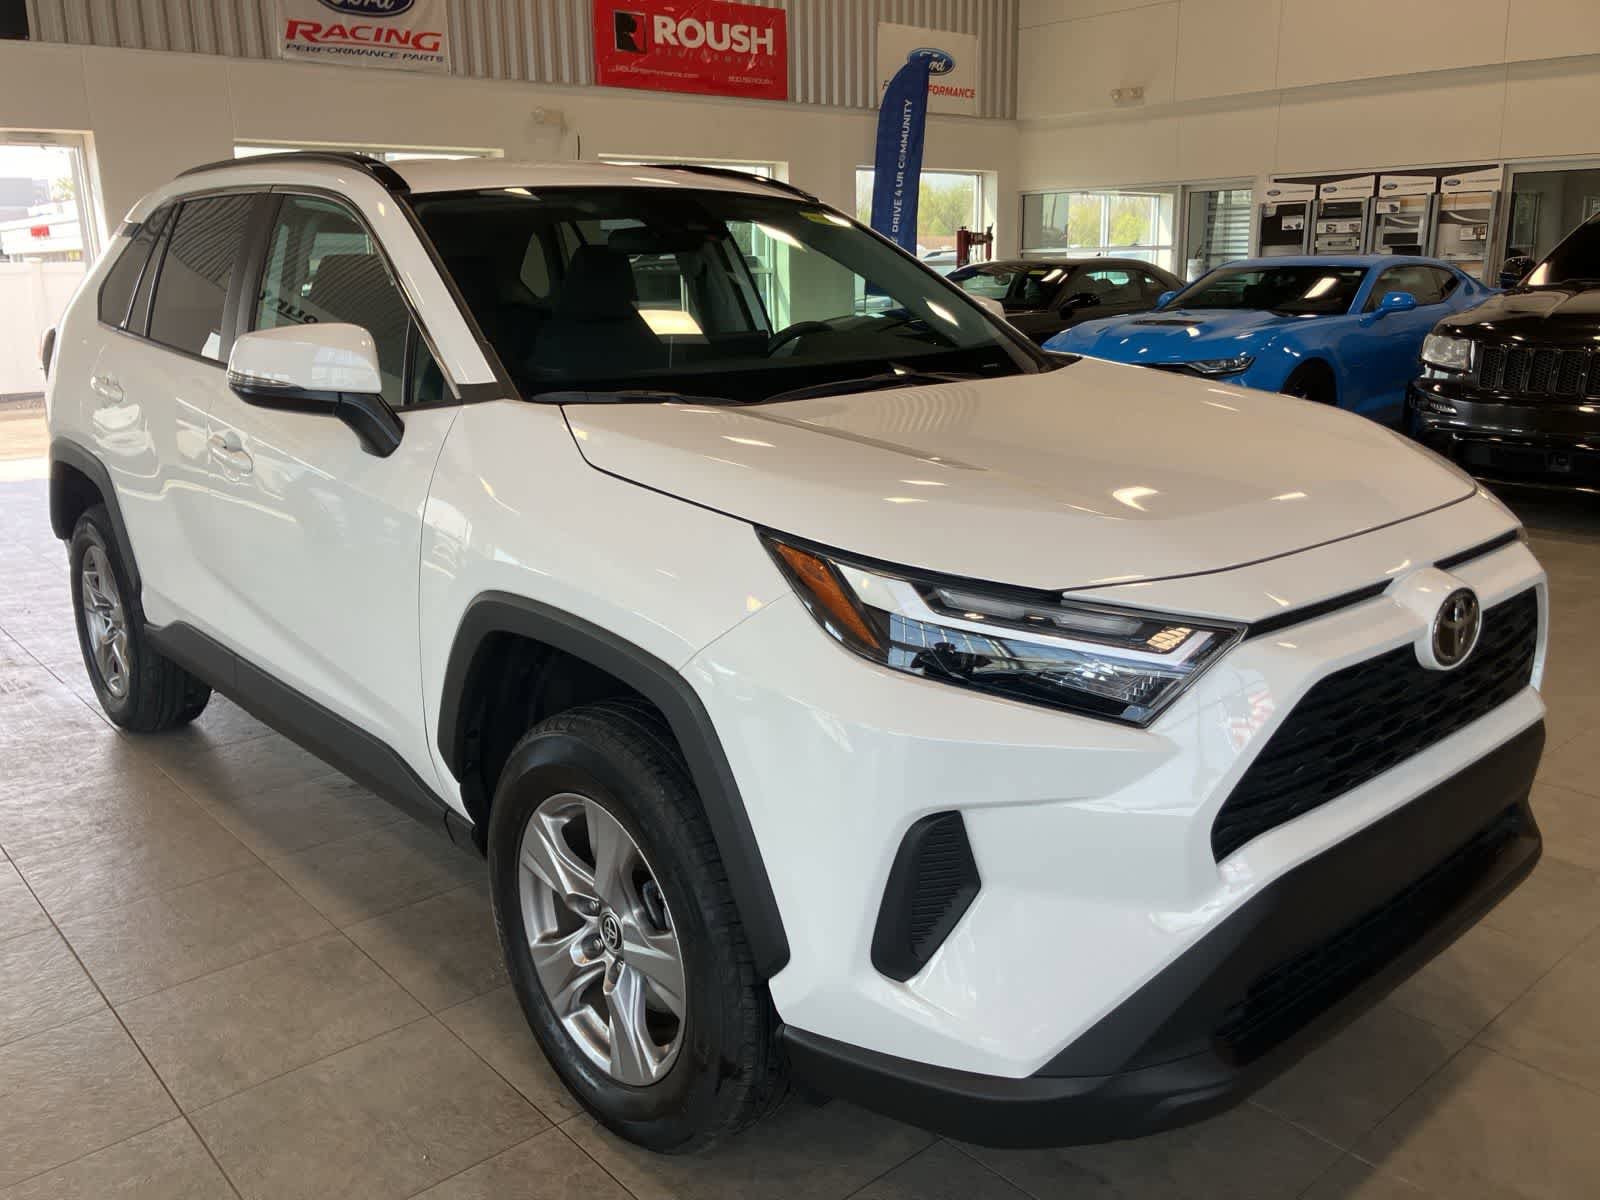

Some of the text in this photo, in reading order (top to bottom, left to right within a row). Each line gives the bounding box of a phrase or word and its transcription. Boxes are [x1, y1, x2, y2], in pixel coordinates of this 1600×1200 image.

[285, 20, 442, 52] RACING
[653, 15, 773, 56] ROUSH
[286, 43, 444, 63] PERFORMANCE PARTS
[927, 84, 977, 98] FORMANCE
[892, 98, 913, 233] DRIVE 4 UR COMMUNITY
